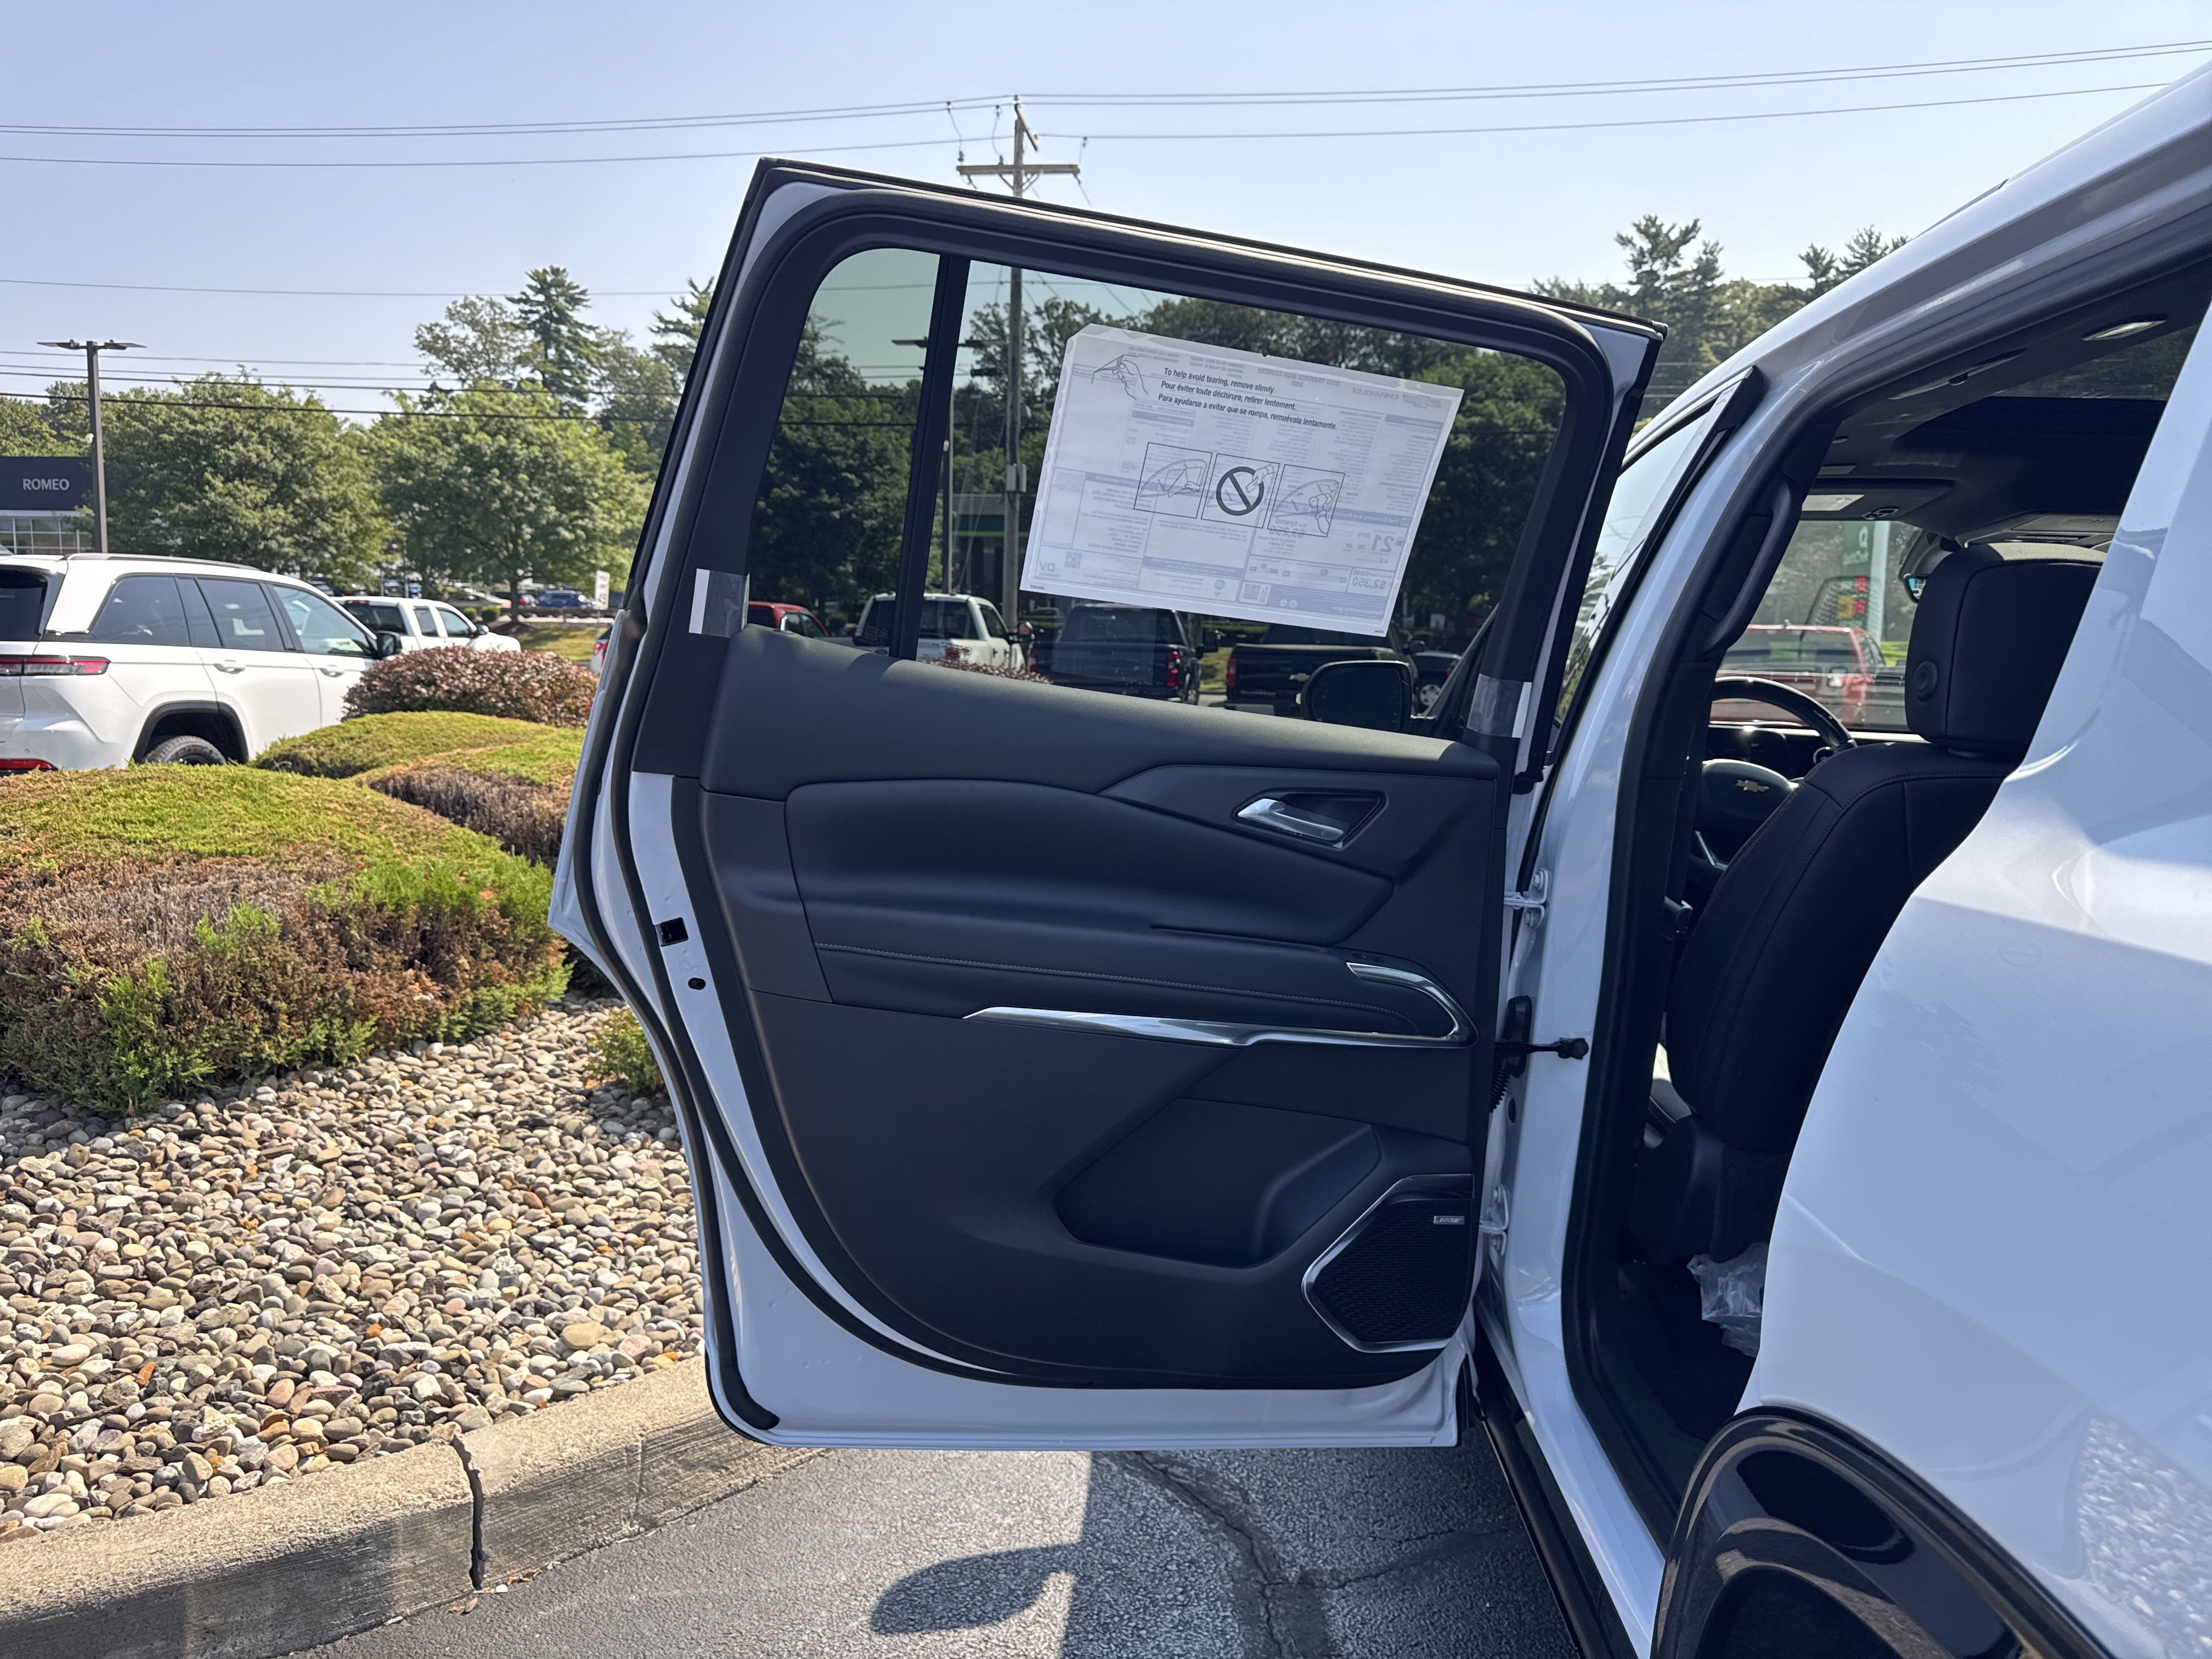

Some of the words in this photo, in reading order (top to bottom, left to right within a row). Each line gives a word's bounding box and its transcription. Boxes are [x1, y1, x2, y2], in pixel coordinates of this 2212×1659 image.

[1172, 369, 1187, 379] help
[1188, 372, 1205, 381] avoid
[1205, 375, 1229, 386] tearing,
[1230, 380, 1254, 389] remove
[1254, 383, 1276, 394] slowly.
[1160, 381, 1176, 390] Pour
[1177, 383, 1195, 393] éviter
[1195, 387, 1211, 396] toute
[1212, 390, 1244, 402] déchirure,
[1244, 394, 1264, 404] retirer
[1264, 398, 1297, 410] lentement.
[1158, 393, 1173, 402] Para
[1173, 397, 1203, 408] ayudarse
[1209, 402, 1227, 411] evitar
[1226, 406, 1238, 414] que
[1247, 409, 1269, 419] rompa,
[1270, 411, 1302, 424] remuévala
[1302, 417, 1338, 430] lentamente.
[22, 478, 70, 491] ROMEO
